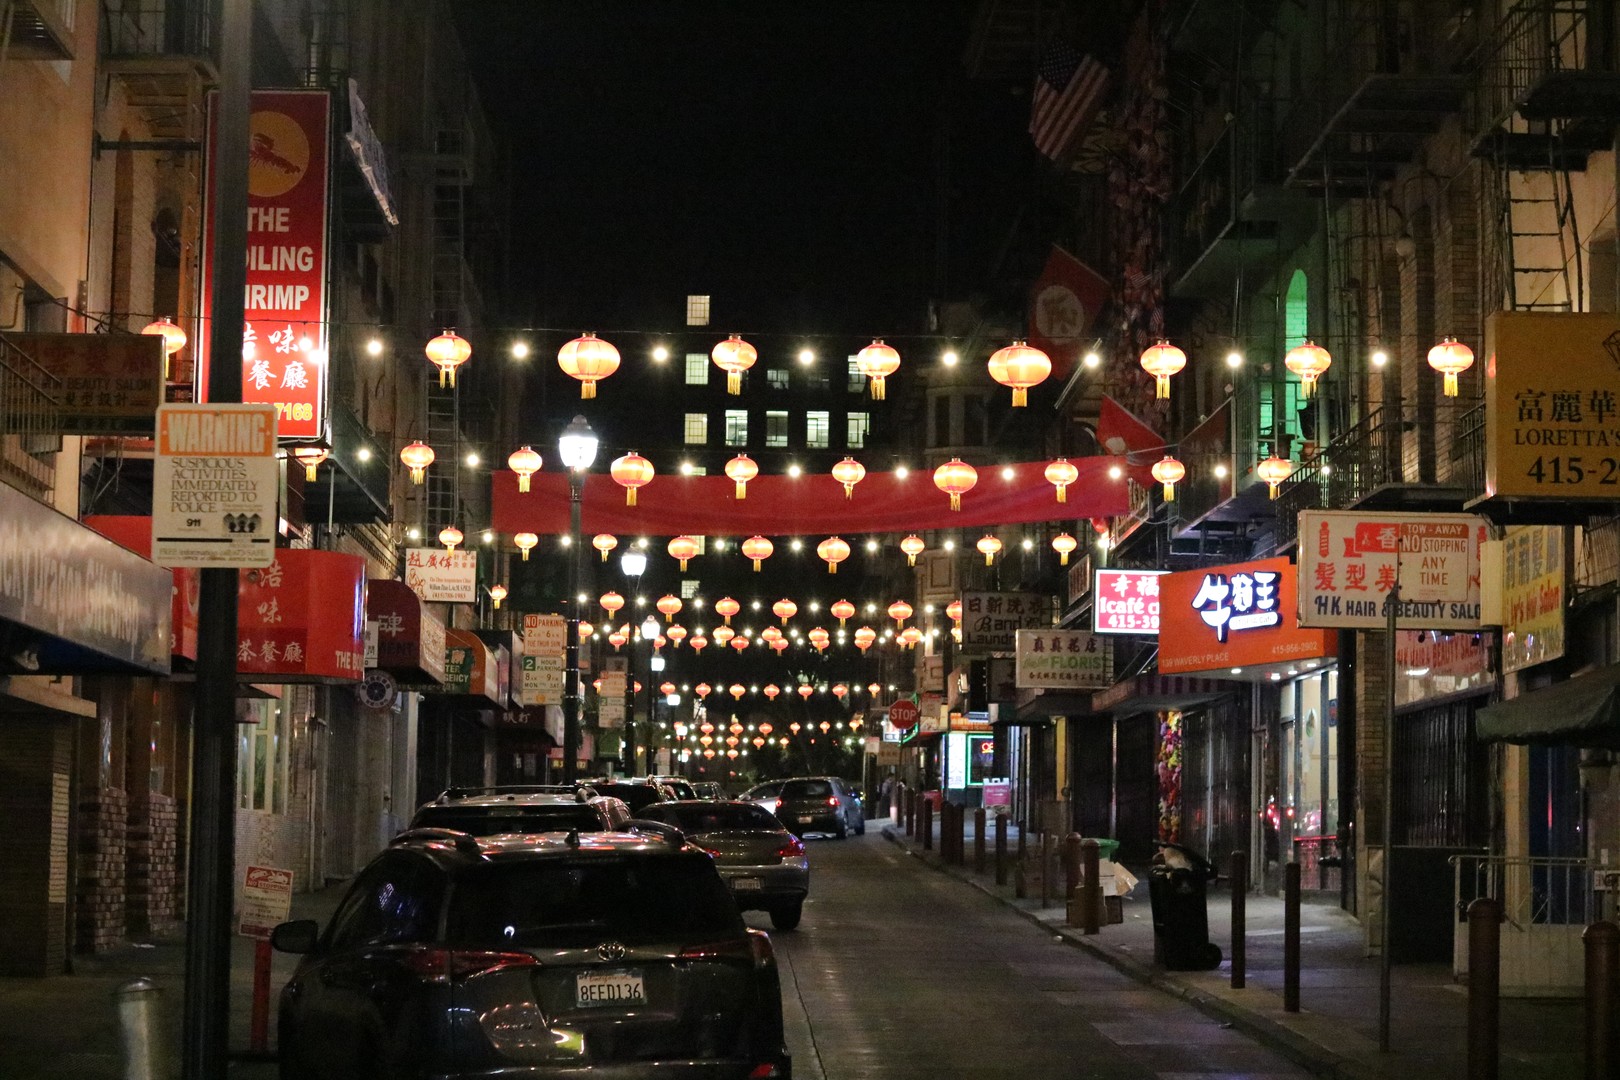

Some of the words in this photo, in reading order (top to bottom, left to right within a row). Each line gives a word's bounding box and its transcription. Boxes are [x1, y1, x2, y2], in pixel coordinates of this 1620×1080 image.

[247, 207, 290, 232] THE
[246, 246, 314, 272] ILING
[1515, 389, 1617, 424] 富麗華
[168, 412, 266, 453] WARNING
[171, 458, 246, 468] SUSPICIOUS
[172, 469, 247, 479] ACTIVITIES
[1527, 456, 1620, 485] 415-2
[171, 480, 258, 490] IMMEDIATELY
[171, 491, 238, 502] REPORTED
[240, 492, 258, 502] TO
[1402, 535, 1420, 552] NO
[1424, 540, 1466, 552] STOPPING
[1421, 557, 1447, 569] ANY
[1420, 572, 1449, 585] TIME
[1346, 600, 1376, 617] HAIR
[1395, 601, 1445, 618] BEAUTY
[525, 616, 537, 627] NO
[539, 619, 564, 627] PARKING
[237, 640, 303, 663] 茶餐廳
[336, 651, 350, 669] THE
[526, 659, 534, 670] 2
[1174, 655, 1205, 666] WAVERLY
[1206, 652, 1229, 662] PLACE
[891, 709, 917, 720] STOP
[260, 882, 289, 891] STOPPING
[580, 983, 641, 1001] 8EED136
